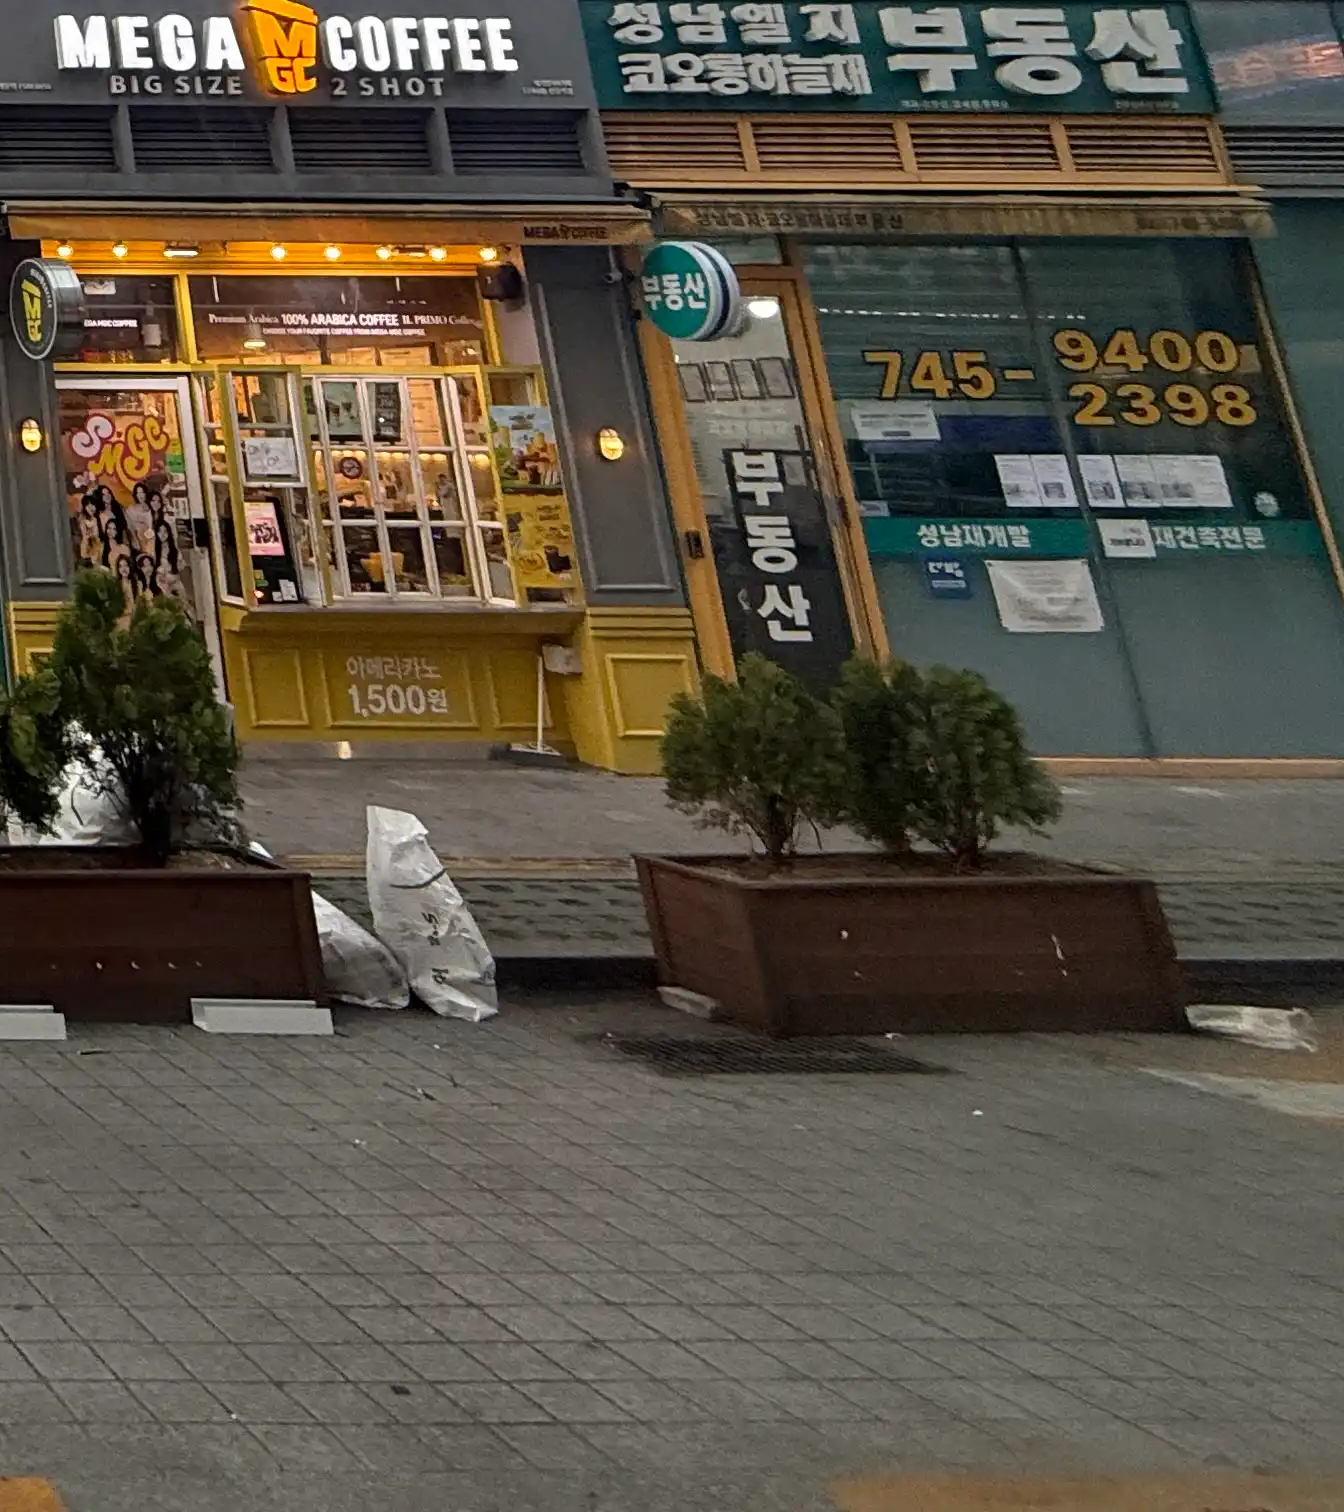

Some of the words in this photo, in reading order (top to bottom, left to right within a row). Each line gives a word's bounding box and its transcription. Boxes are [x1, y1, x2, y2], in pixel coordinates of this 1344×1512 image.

[54, 14, 245, 72] MEGA
[321, 15, 520, 73] COFFEE
[878, 6, 1190, 96] 부동산
[110, 74, 166, 96] BIG
[175, 74, 245, 97] SIZE
[332, 76, 350, 97] 2
[359, 76, 446, 97] SHOT
[641, 272, 708, 312] 부동산
[281, 313, 309, 326] 100%
[310, 313, 357, 326] ARABICA
[358, 314, 400, 326] COFFEE
[863, 350, 1035, 400] 745-
[1052, 329, 1240, 373] 9400
[1068, 383, 1258, 426] 2398
[730, 450, 814, 643] 부동산
[346, 655, 442, 680] 아메리카노
[347, 686, 449, 718] 1,500원
